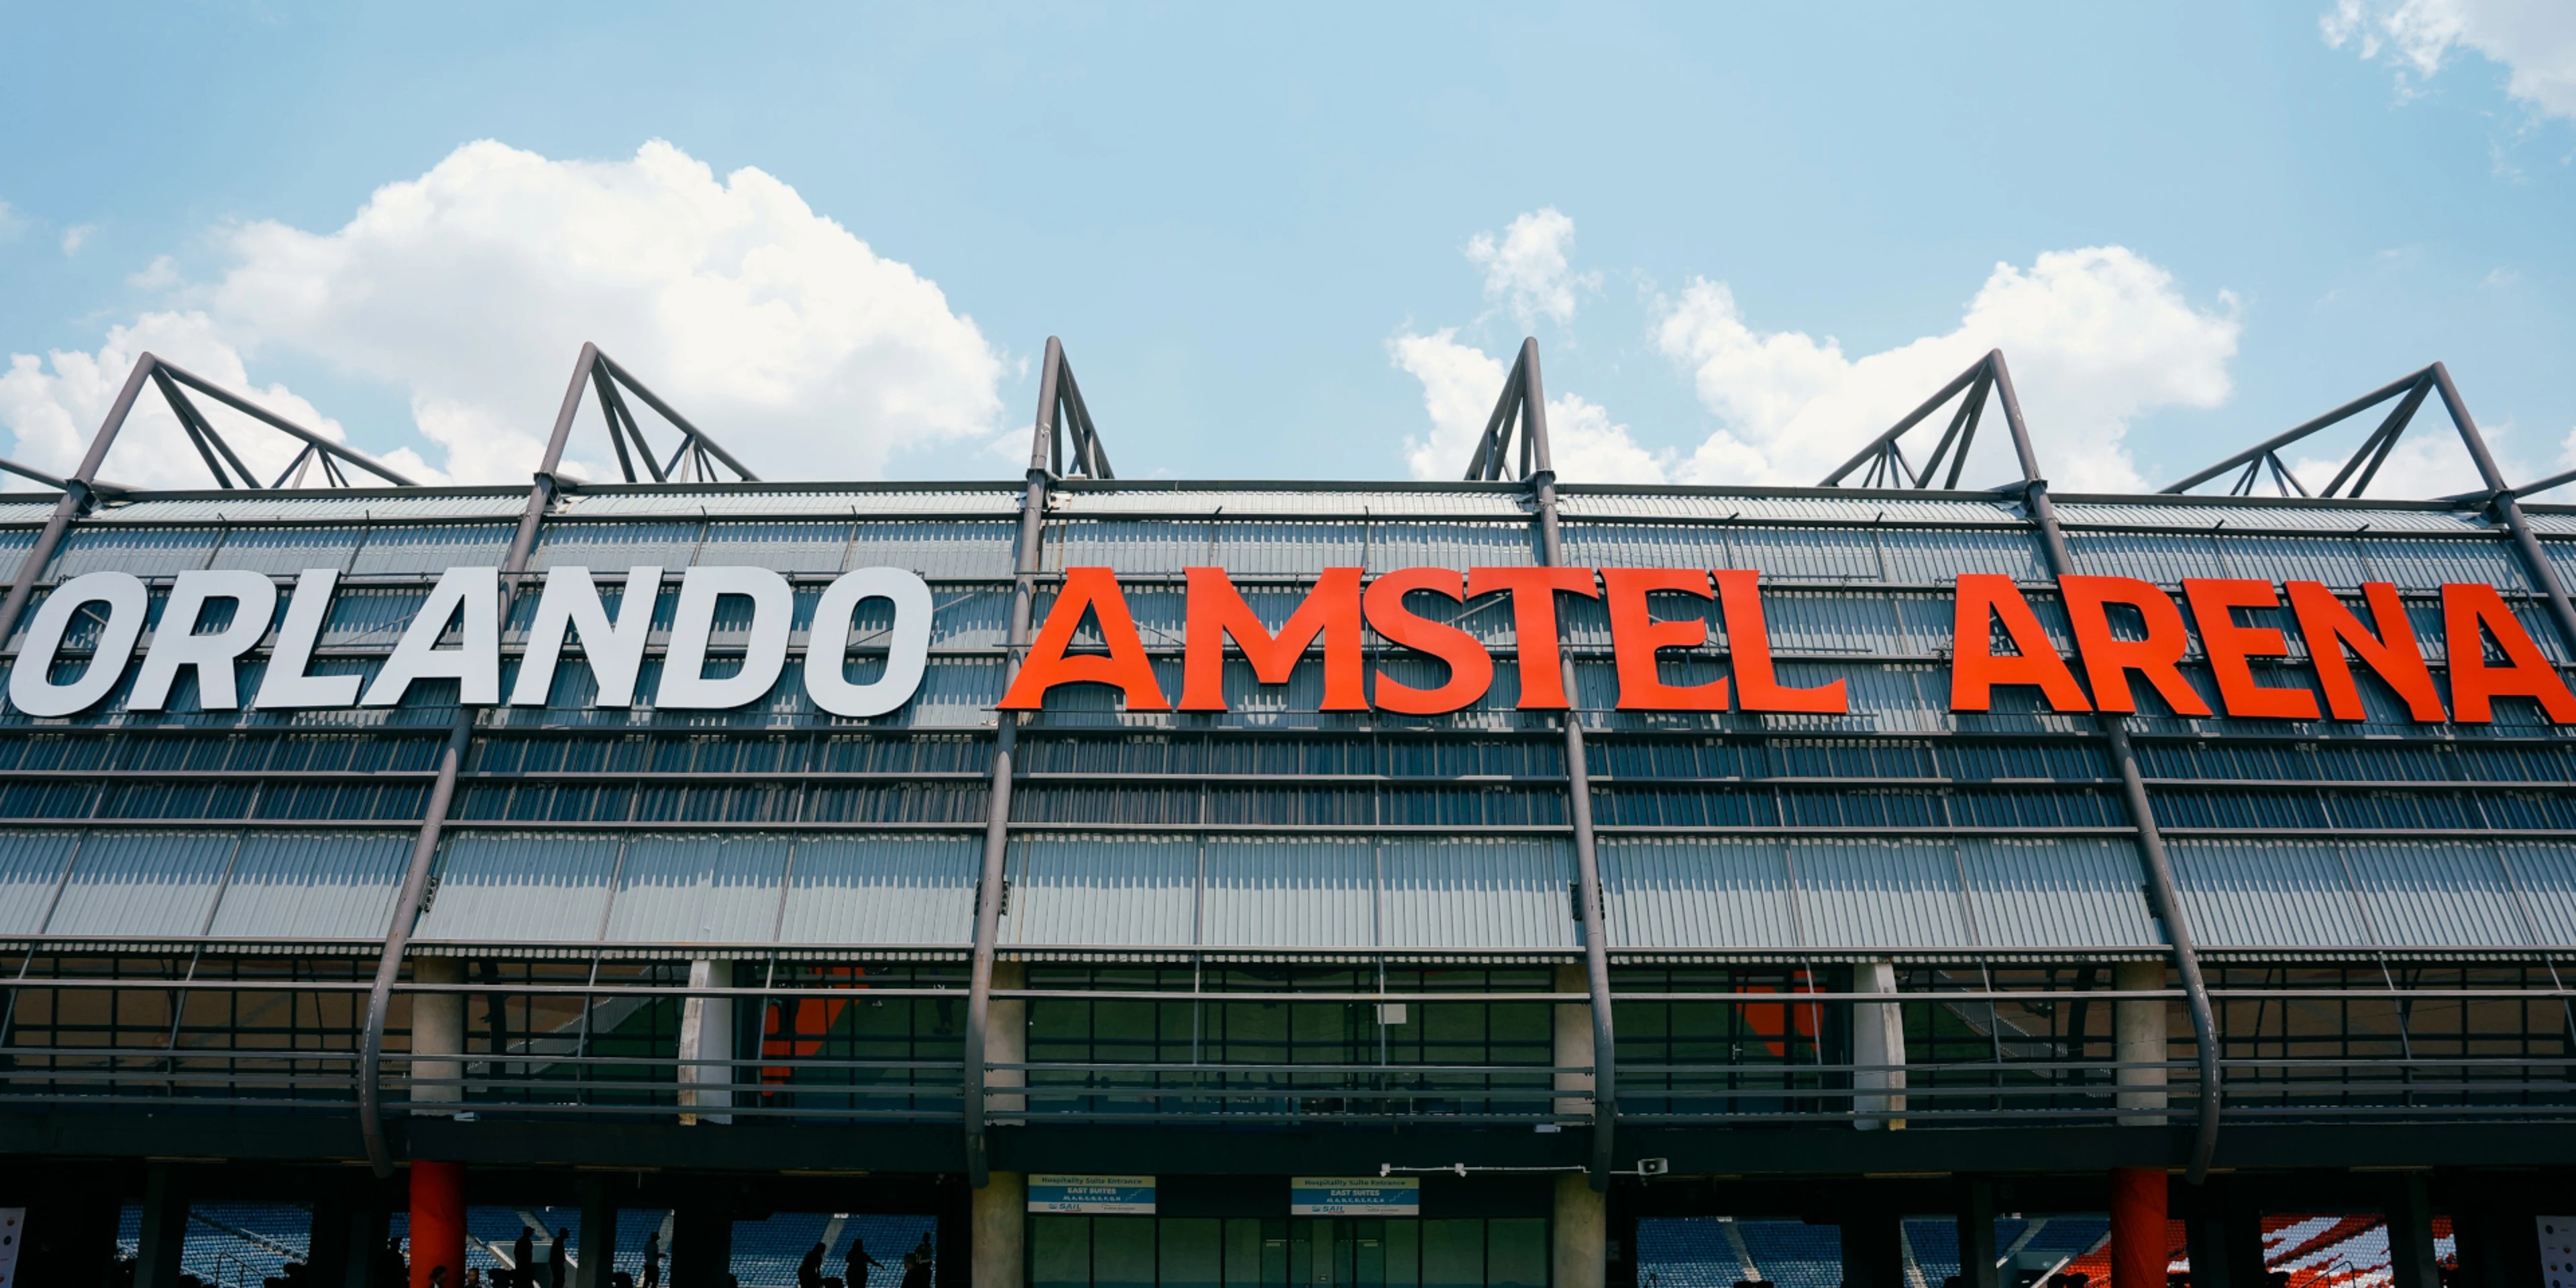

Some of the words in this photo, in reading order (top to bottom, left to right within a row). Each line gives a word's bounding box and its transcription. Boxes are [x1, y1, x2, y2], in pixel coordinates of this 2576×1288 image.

[9, 566, 933, 717] ORLANDO
[996, 566, 1847, 714] AMSTEL
[1950, 573, 2576, 724] ARENA
